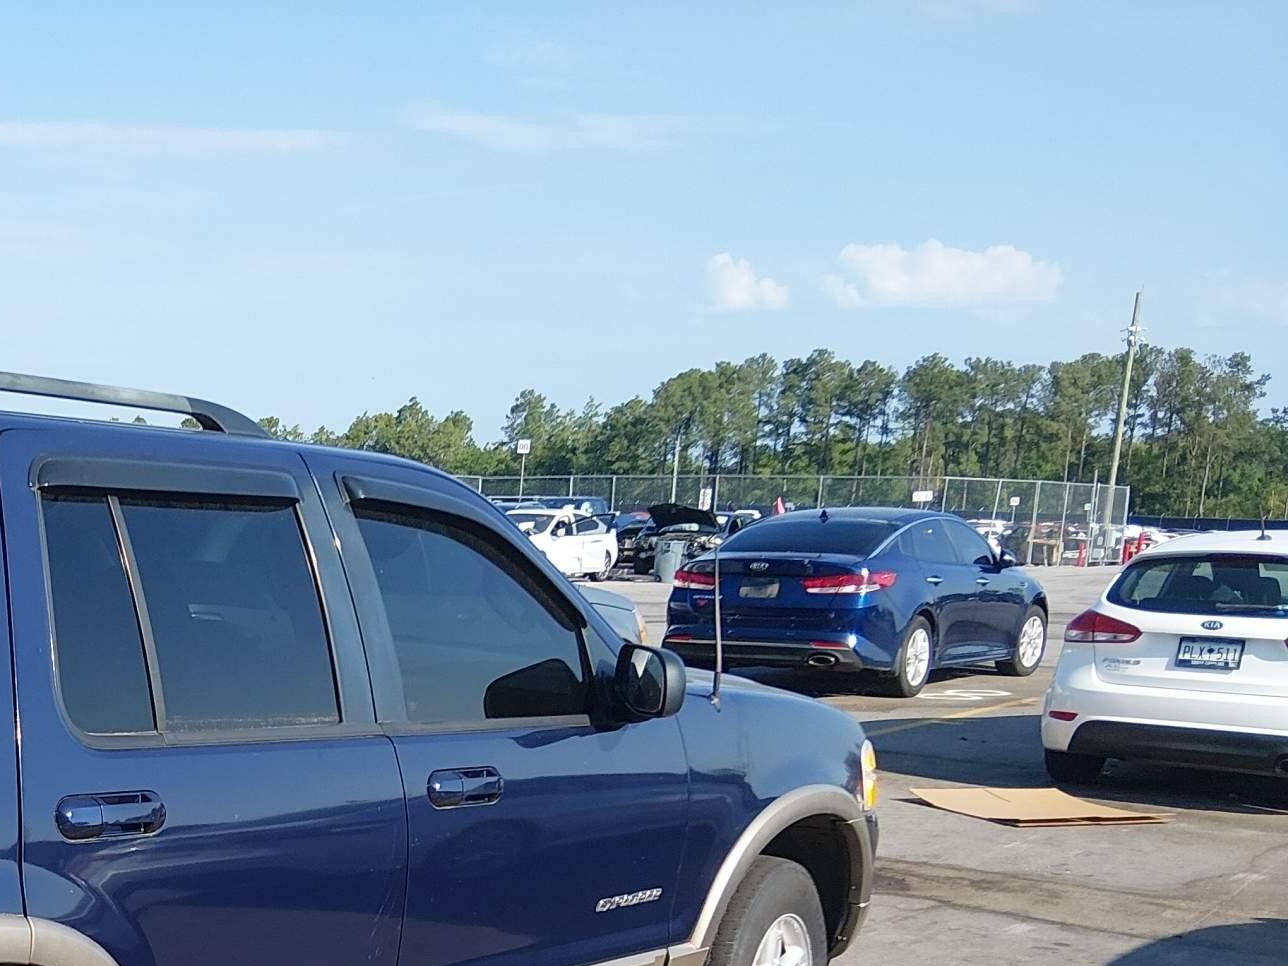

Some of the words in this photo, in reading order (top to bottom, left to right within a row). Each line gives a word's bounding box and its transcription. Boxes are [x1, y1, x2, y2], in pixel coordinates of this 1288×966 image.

[1202, 621, 1222, 629] KIA
[1182, 645, 1205, 659] PLX
[1216, 647, 1238, 661] 511
